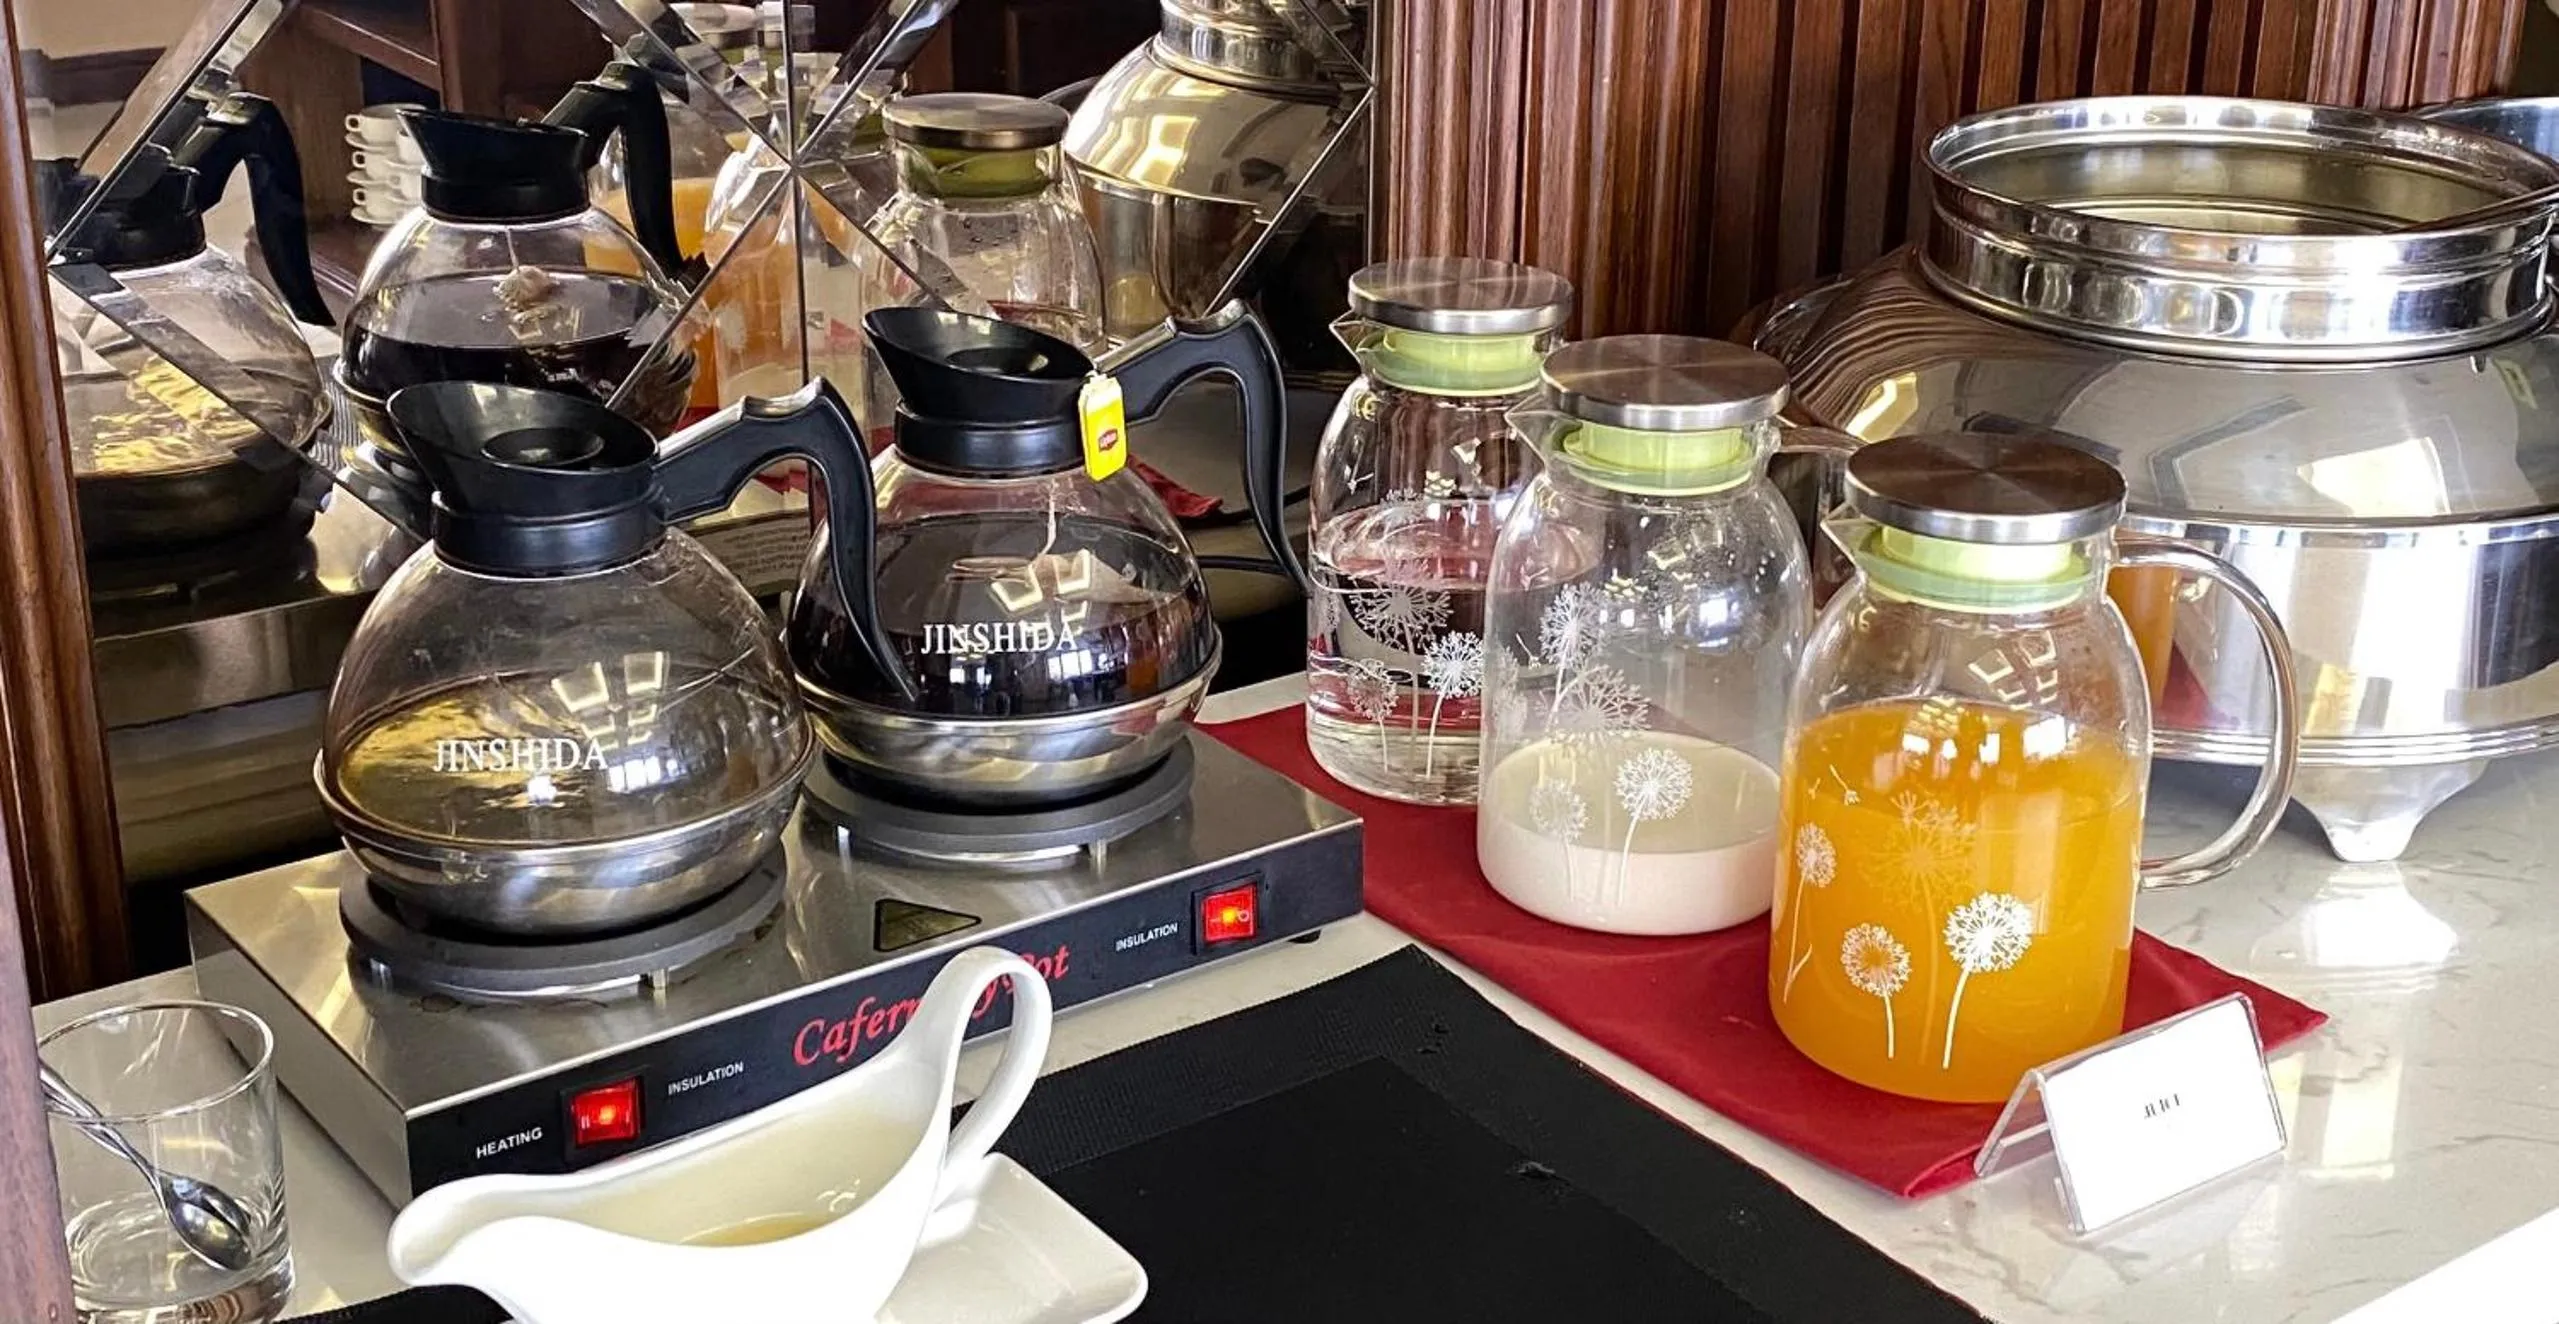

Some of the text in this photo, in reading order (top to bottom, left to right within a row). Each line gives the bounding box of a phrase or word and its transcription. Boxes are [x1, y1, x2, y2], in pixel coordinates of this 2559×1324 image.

[921, 621, 1078, 655] JINSHIDA
[432, 738, 609, 772] JINSHIDA
[1115, 922, 1179, 952] INSULATION
[667, 1060, 745, 1096] INSULATION
[475, 1126, 544, 1159] HEATING
